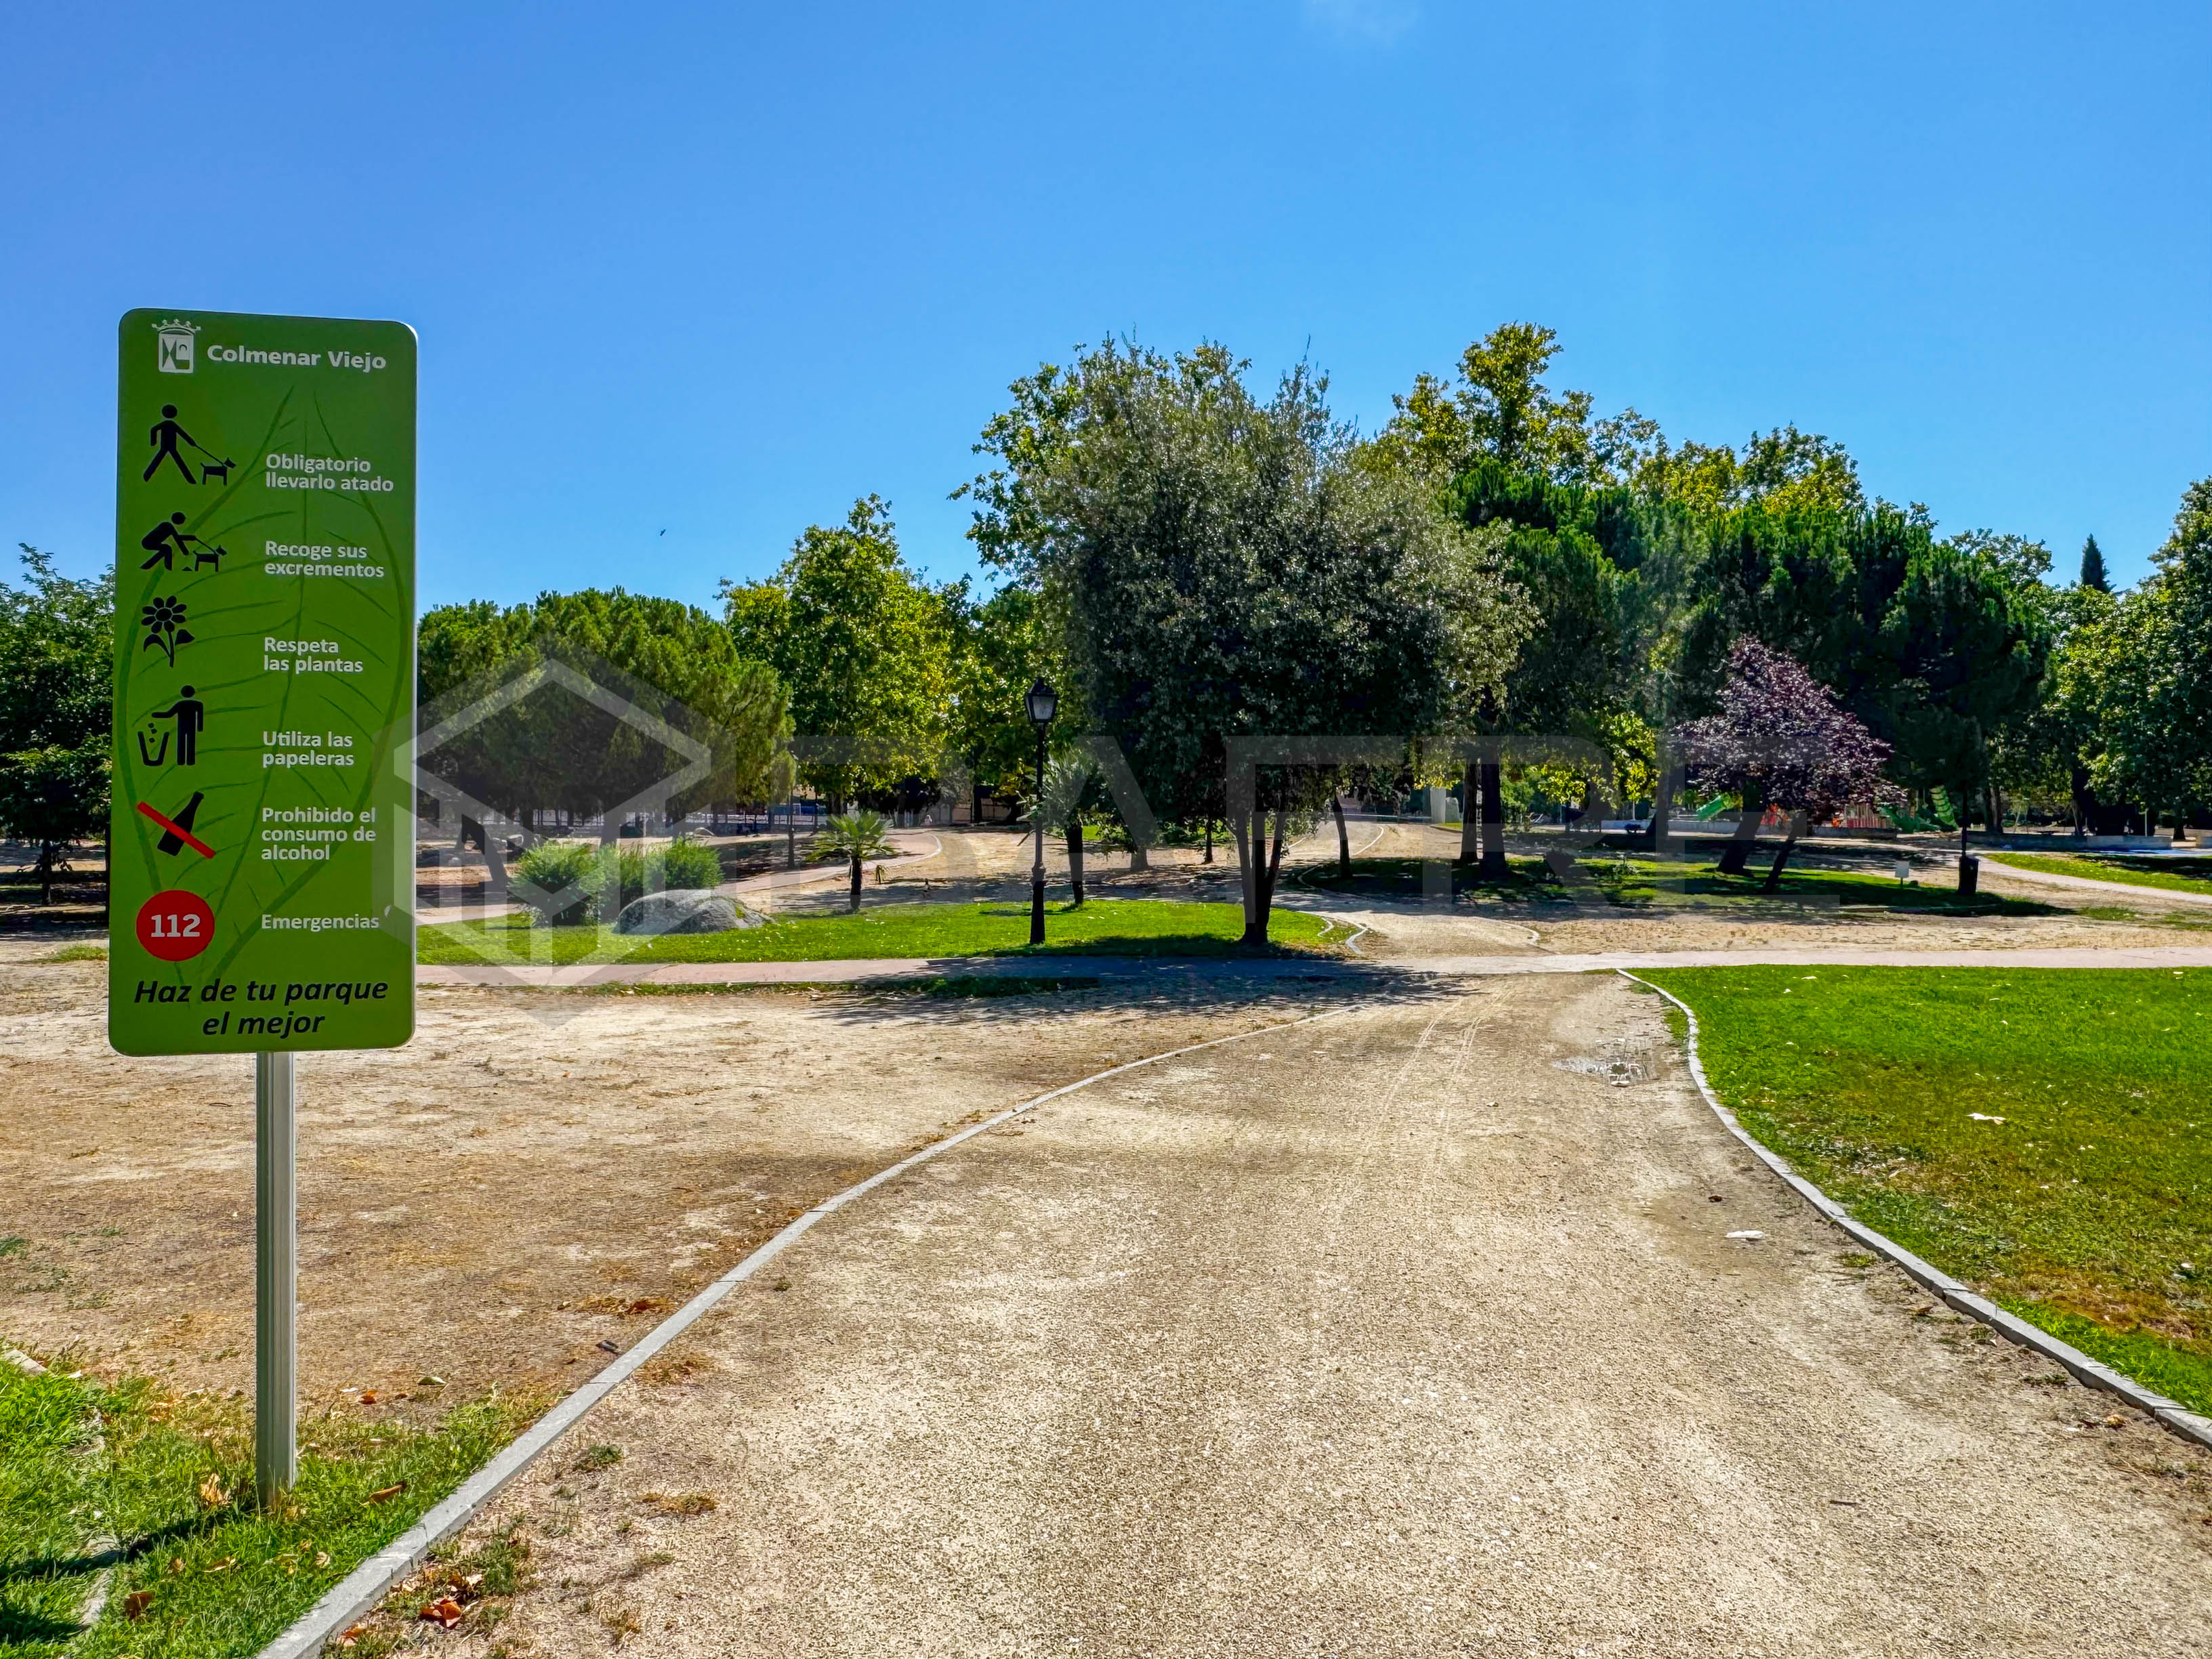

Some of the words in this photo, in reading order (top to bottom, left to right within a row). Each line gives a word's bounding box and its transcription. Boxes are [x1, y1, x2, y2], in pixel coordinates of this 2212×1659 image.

[207, 345, 321, 366] Colmenar
[327, 351, 387, 373] Viejo
[266, 453, 371, 473] Obligatorio
[266, 471, 336, 490] llevarlo
[341, 476, 394, 492] atado
[265, 541, 332, 561] Recoge
[337, 546, 367, 559] sus
[264, 563, 384, 578] excrementos
[264, 637, 339, 656] Respeta
[264, 655, 289, 671] las
[295, 656, 363, 675] plantas
[263, 731, 321, 747] Utiliza
[328, 731, 353, 747] las
[263, 749, 354, 768] papeleras
[262, 807, 354, 822] Prohibido
[360, 807, 376, 823] el
[262, 830, 348, 841] consumo
[353, 826, 377, 841] de
[261, 844, 330, 860] alcohol
[151, 914, 201, 938] 112
[262, 913, 379, 933] Emergencias
[133, 980, 192, 1003] Haz
[201, 978, 237, 1003] de
[247, 980, 277, 1001] tu
[284, 982, 388, 1005] parque
[203, 1011, 230, 1036] el
[237, 1011, 325, 1038] mejor
